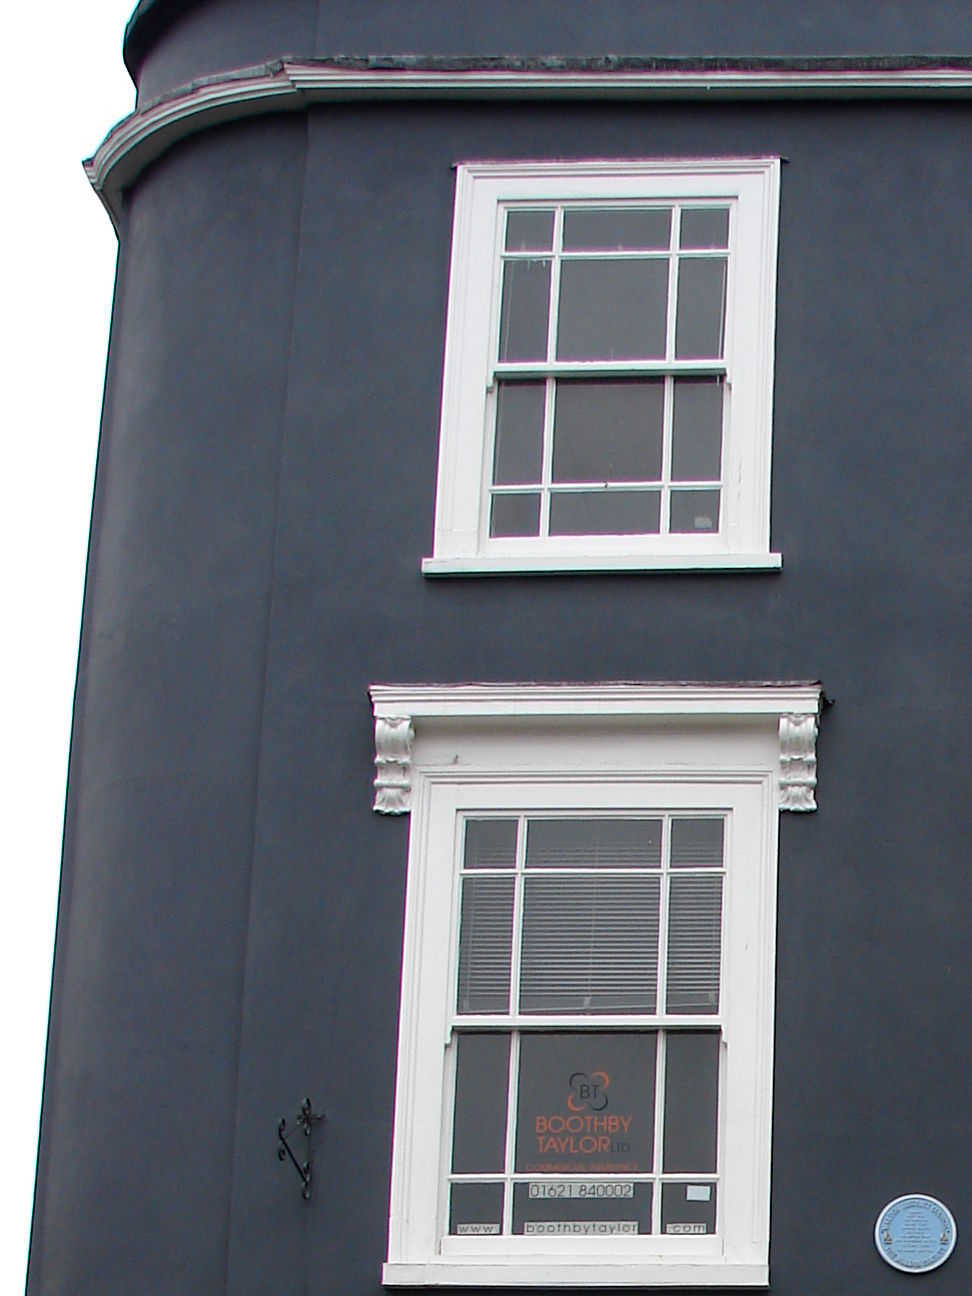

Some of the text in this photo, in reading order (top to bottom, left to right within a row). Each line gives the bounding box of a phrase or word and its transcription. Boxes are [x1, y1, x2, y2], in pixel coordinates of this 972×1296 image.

[579, 1084, 600, 1100] BT
[536, 1115, 633, 1133] BOOTHBY
[537, 1136, 611, 1153] TAYLOR
[530, 1184, 632, 1197] 01621 840002
